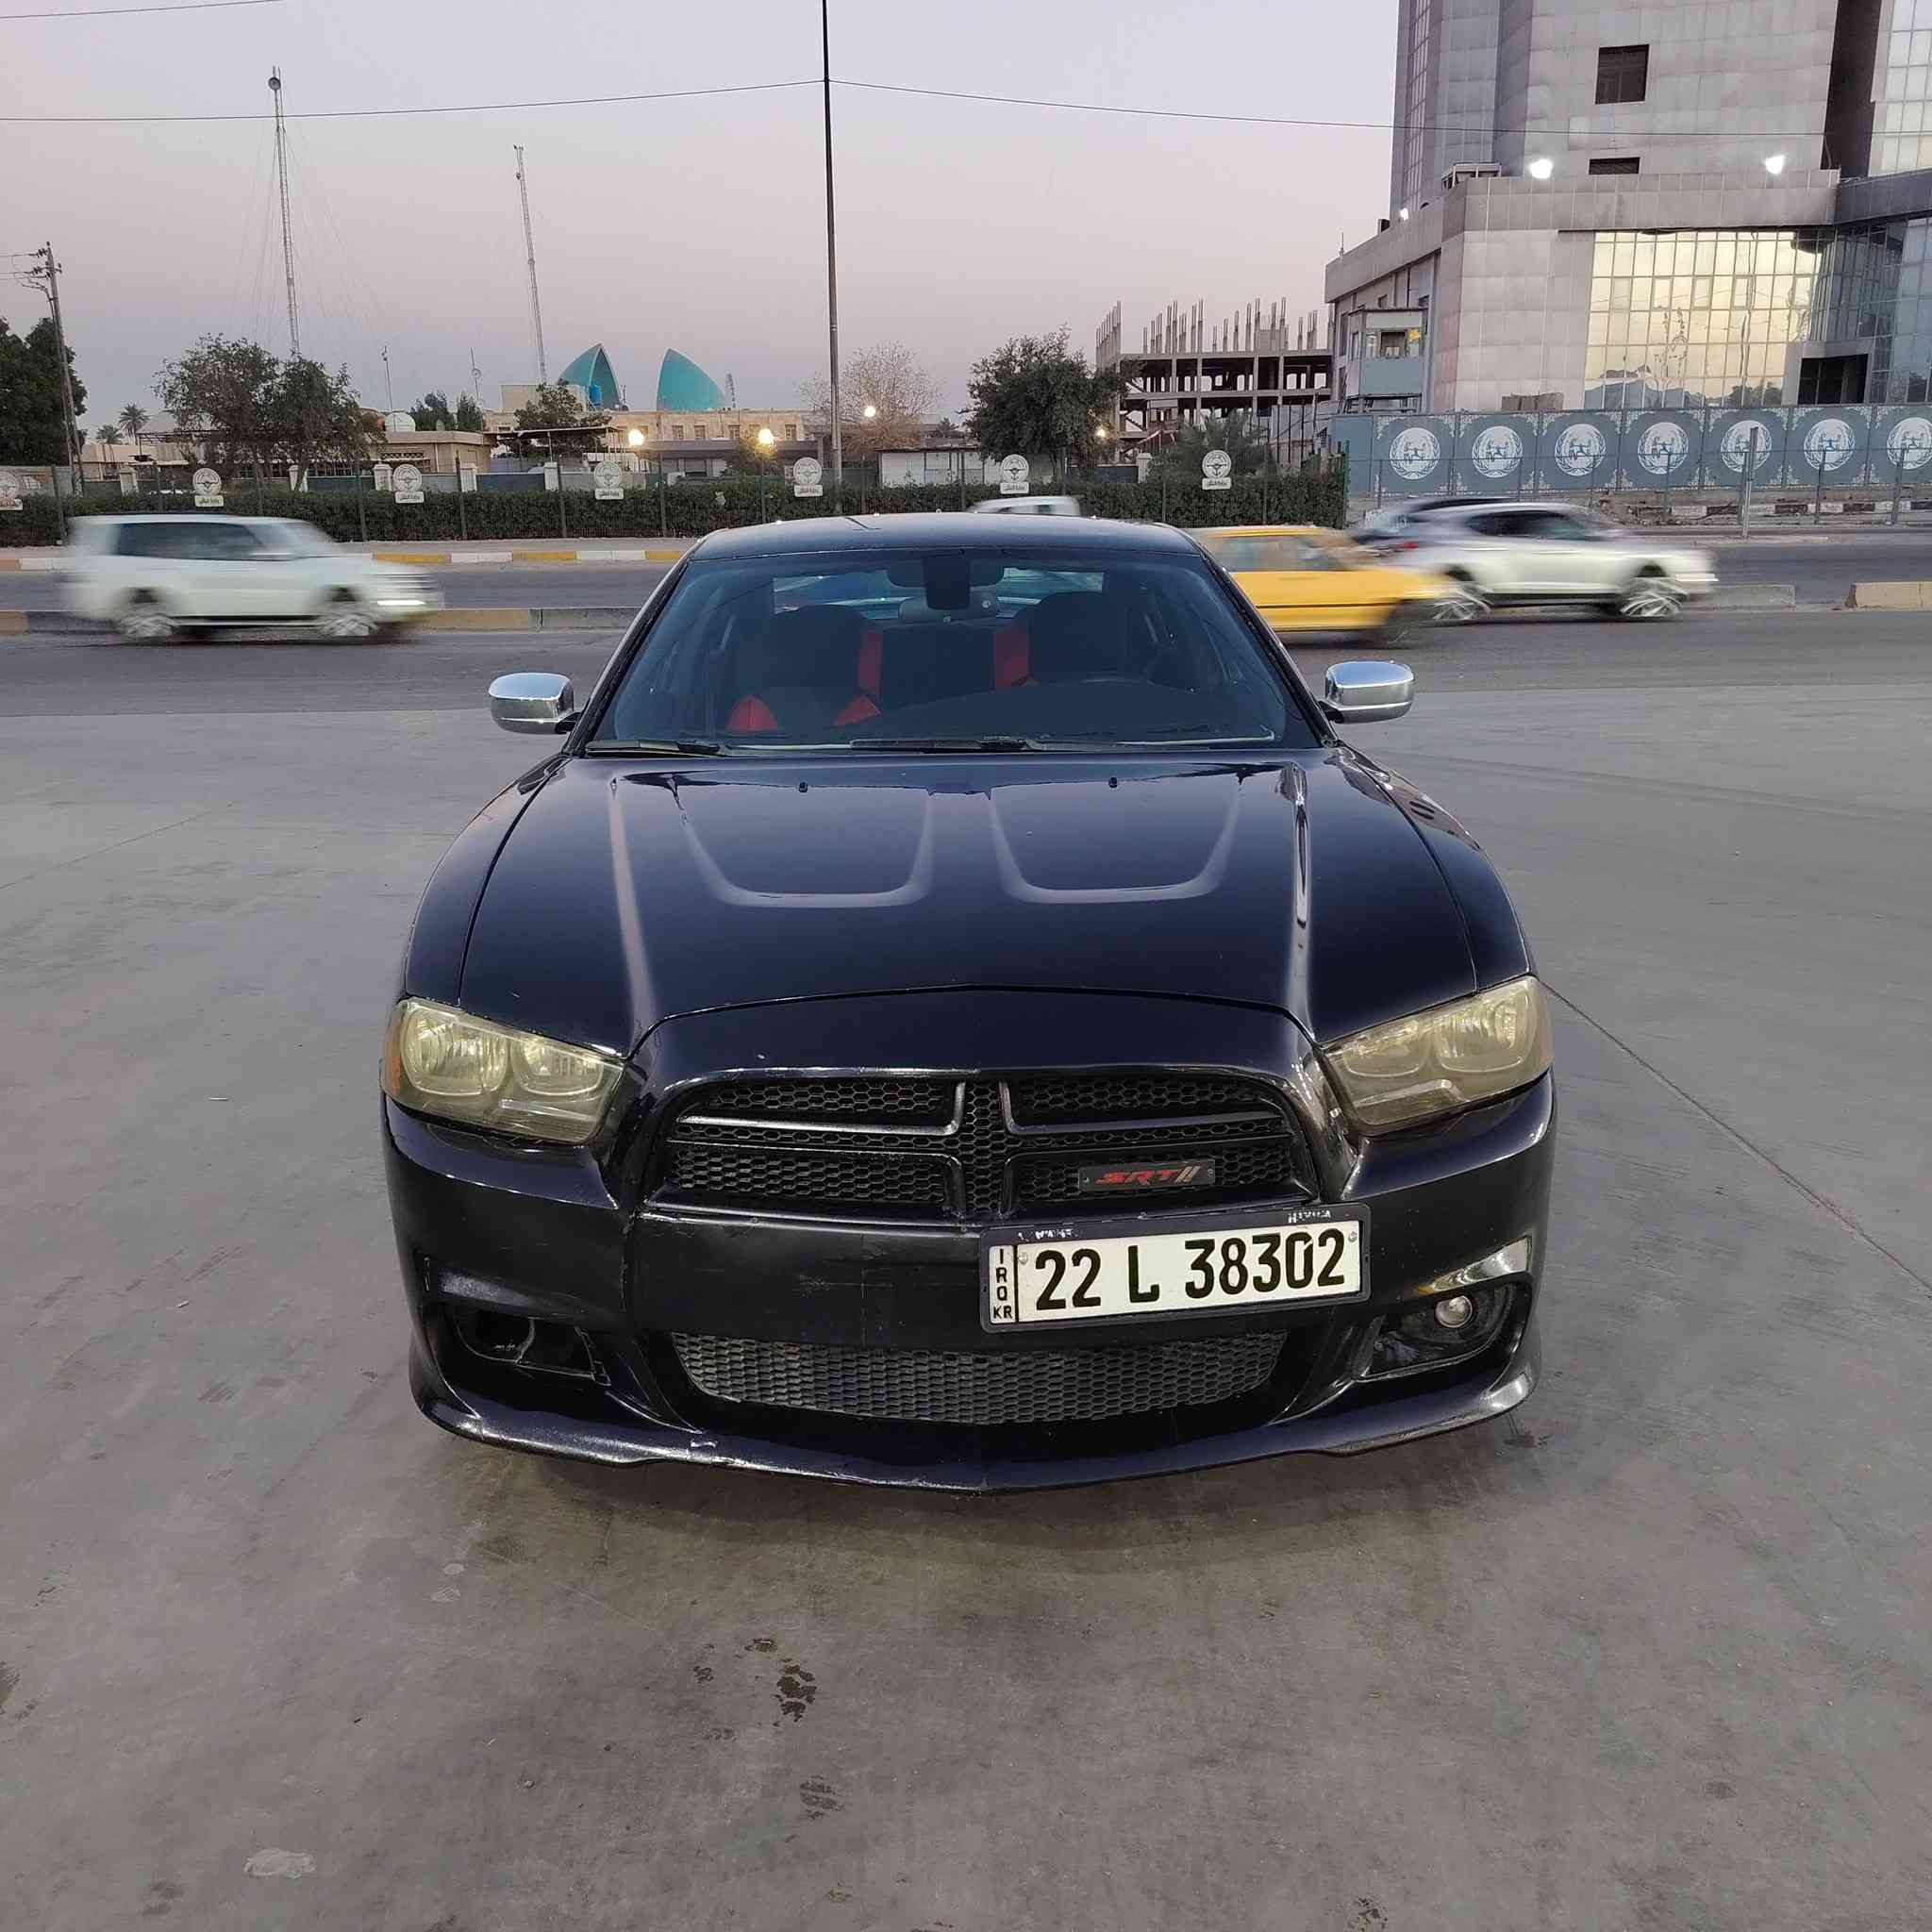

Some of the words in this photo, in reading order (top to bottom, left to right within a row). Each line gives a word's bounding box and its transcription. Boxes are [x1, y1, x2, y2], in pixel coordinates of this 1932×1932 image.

[1035, 1247, 1102, 1311] 22
[1127, 1244, 1160, 1304] L
[1184, 1227, 1346, 1299] 38302
[992, 1305, 1013, 1319] KR
